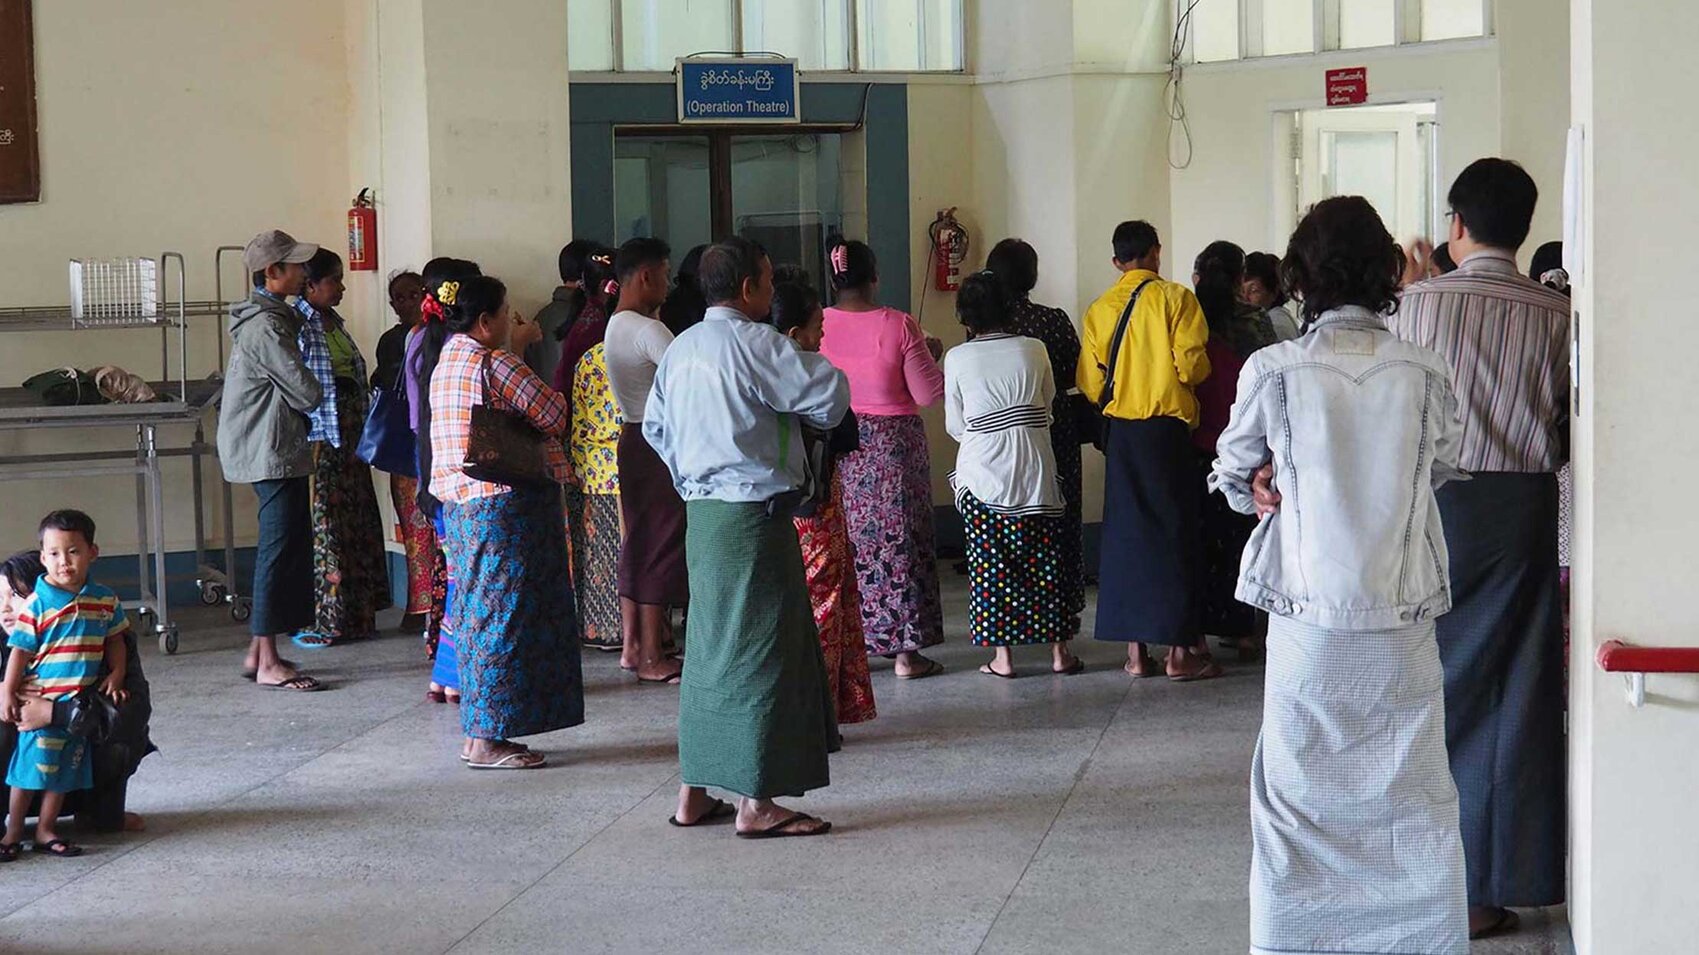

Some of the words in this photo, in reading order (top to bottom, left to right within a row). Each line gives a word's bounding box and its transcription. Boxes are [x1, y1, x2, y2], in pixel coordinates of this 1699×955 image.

[700, 69, 774, 91] ခွဲစိတ်ခန်းမကြီး
[687, 100, 743, 115] (Operation
[746, 100, 790, 115] Theatre)
